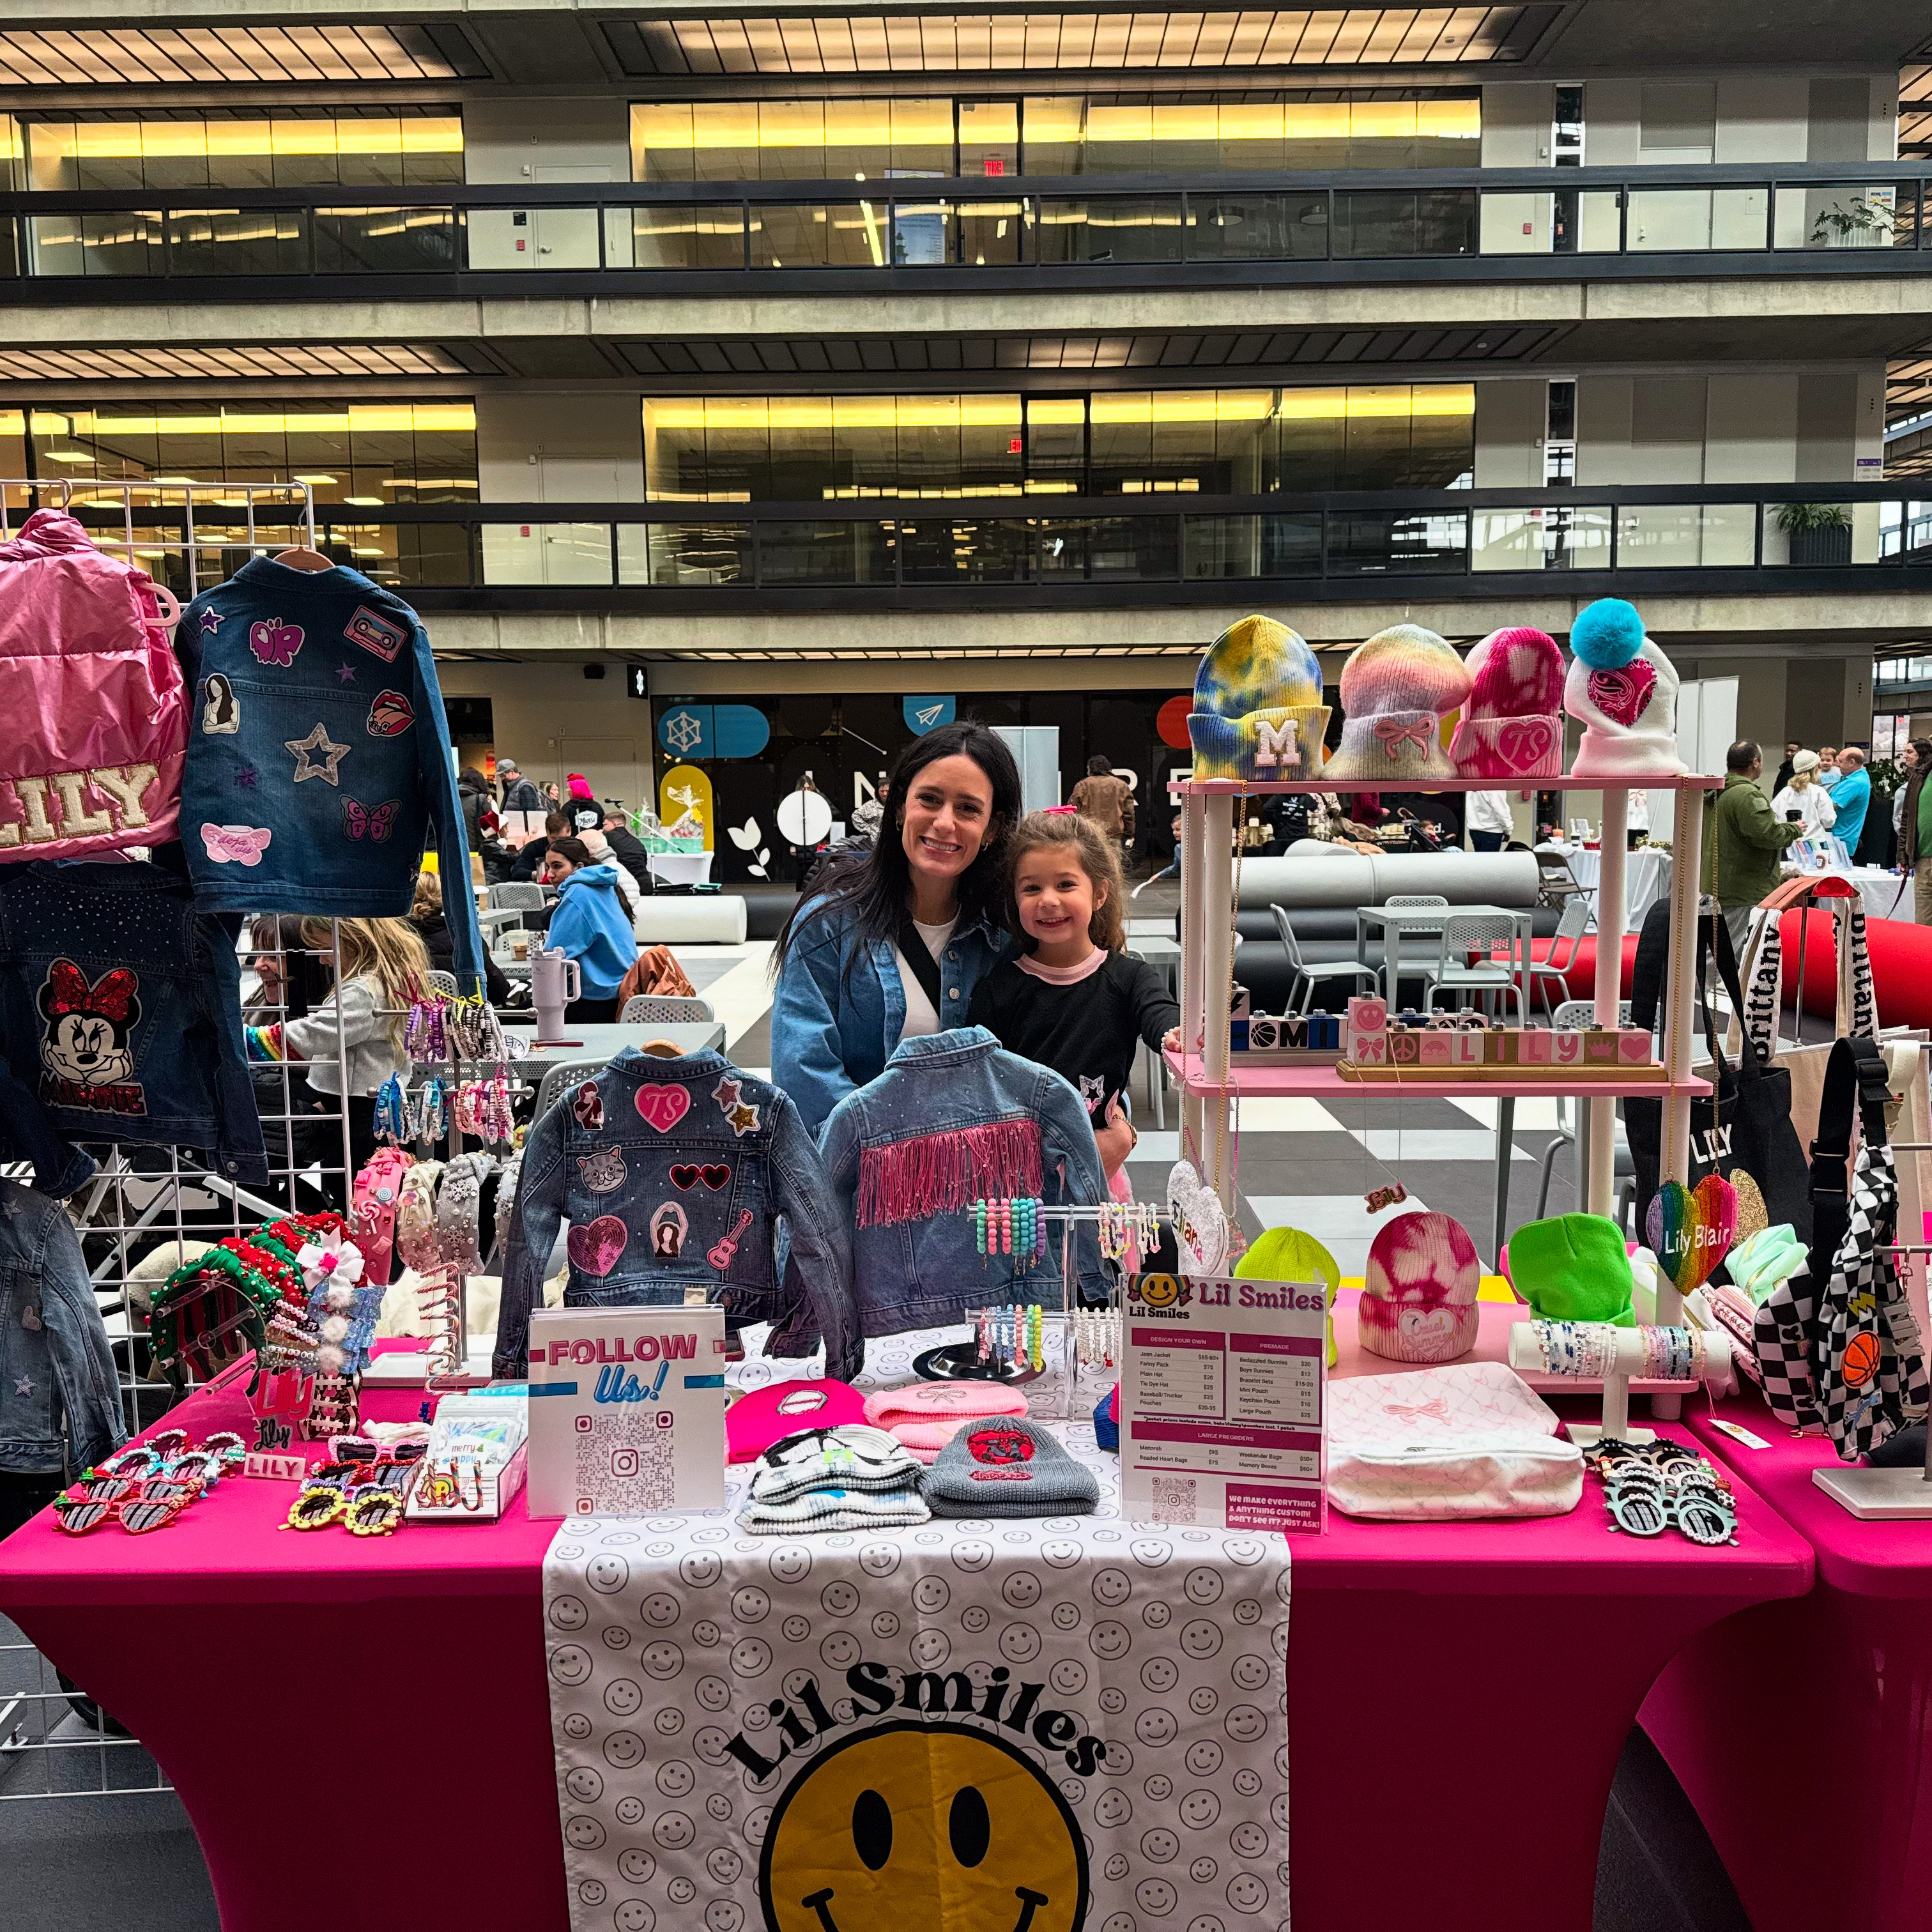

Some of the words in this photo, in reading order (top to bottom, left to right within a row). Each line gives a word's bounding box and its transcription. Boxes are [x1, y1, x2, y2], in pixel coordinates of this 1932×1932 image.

[1253, 718, 1301, 767] M
[1508, 728, 1548, 762] TS
[645, 1092, 684, 1121] TS
[1689, 1123, 1733, 1164] LILY
[1664, 1229, 1692, 1258] Lily
[1694, 1222, 1730, 1249] Blair
[1199, 1282, 1230, 1305] Lil
[1238, 1284, 1324, 1310] Smiles
[1129, 1306, 1146, 1317] Lil
[1147, 1307, 1190, 1319] Smiles
[549, 1333, 697, 1366] FOLLOW
[451, 1443, 476, 1454] merry
[1218, 1434, 1255, 1442] PREORDERS
[247, 1457, 298, 1476] LILY
[723, 1678, 838, 1784] Lil
[845, 1661, 1107, 1777] Smiles
